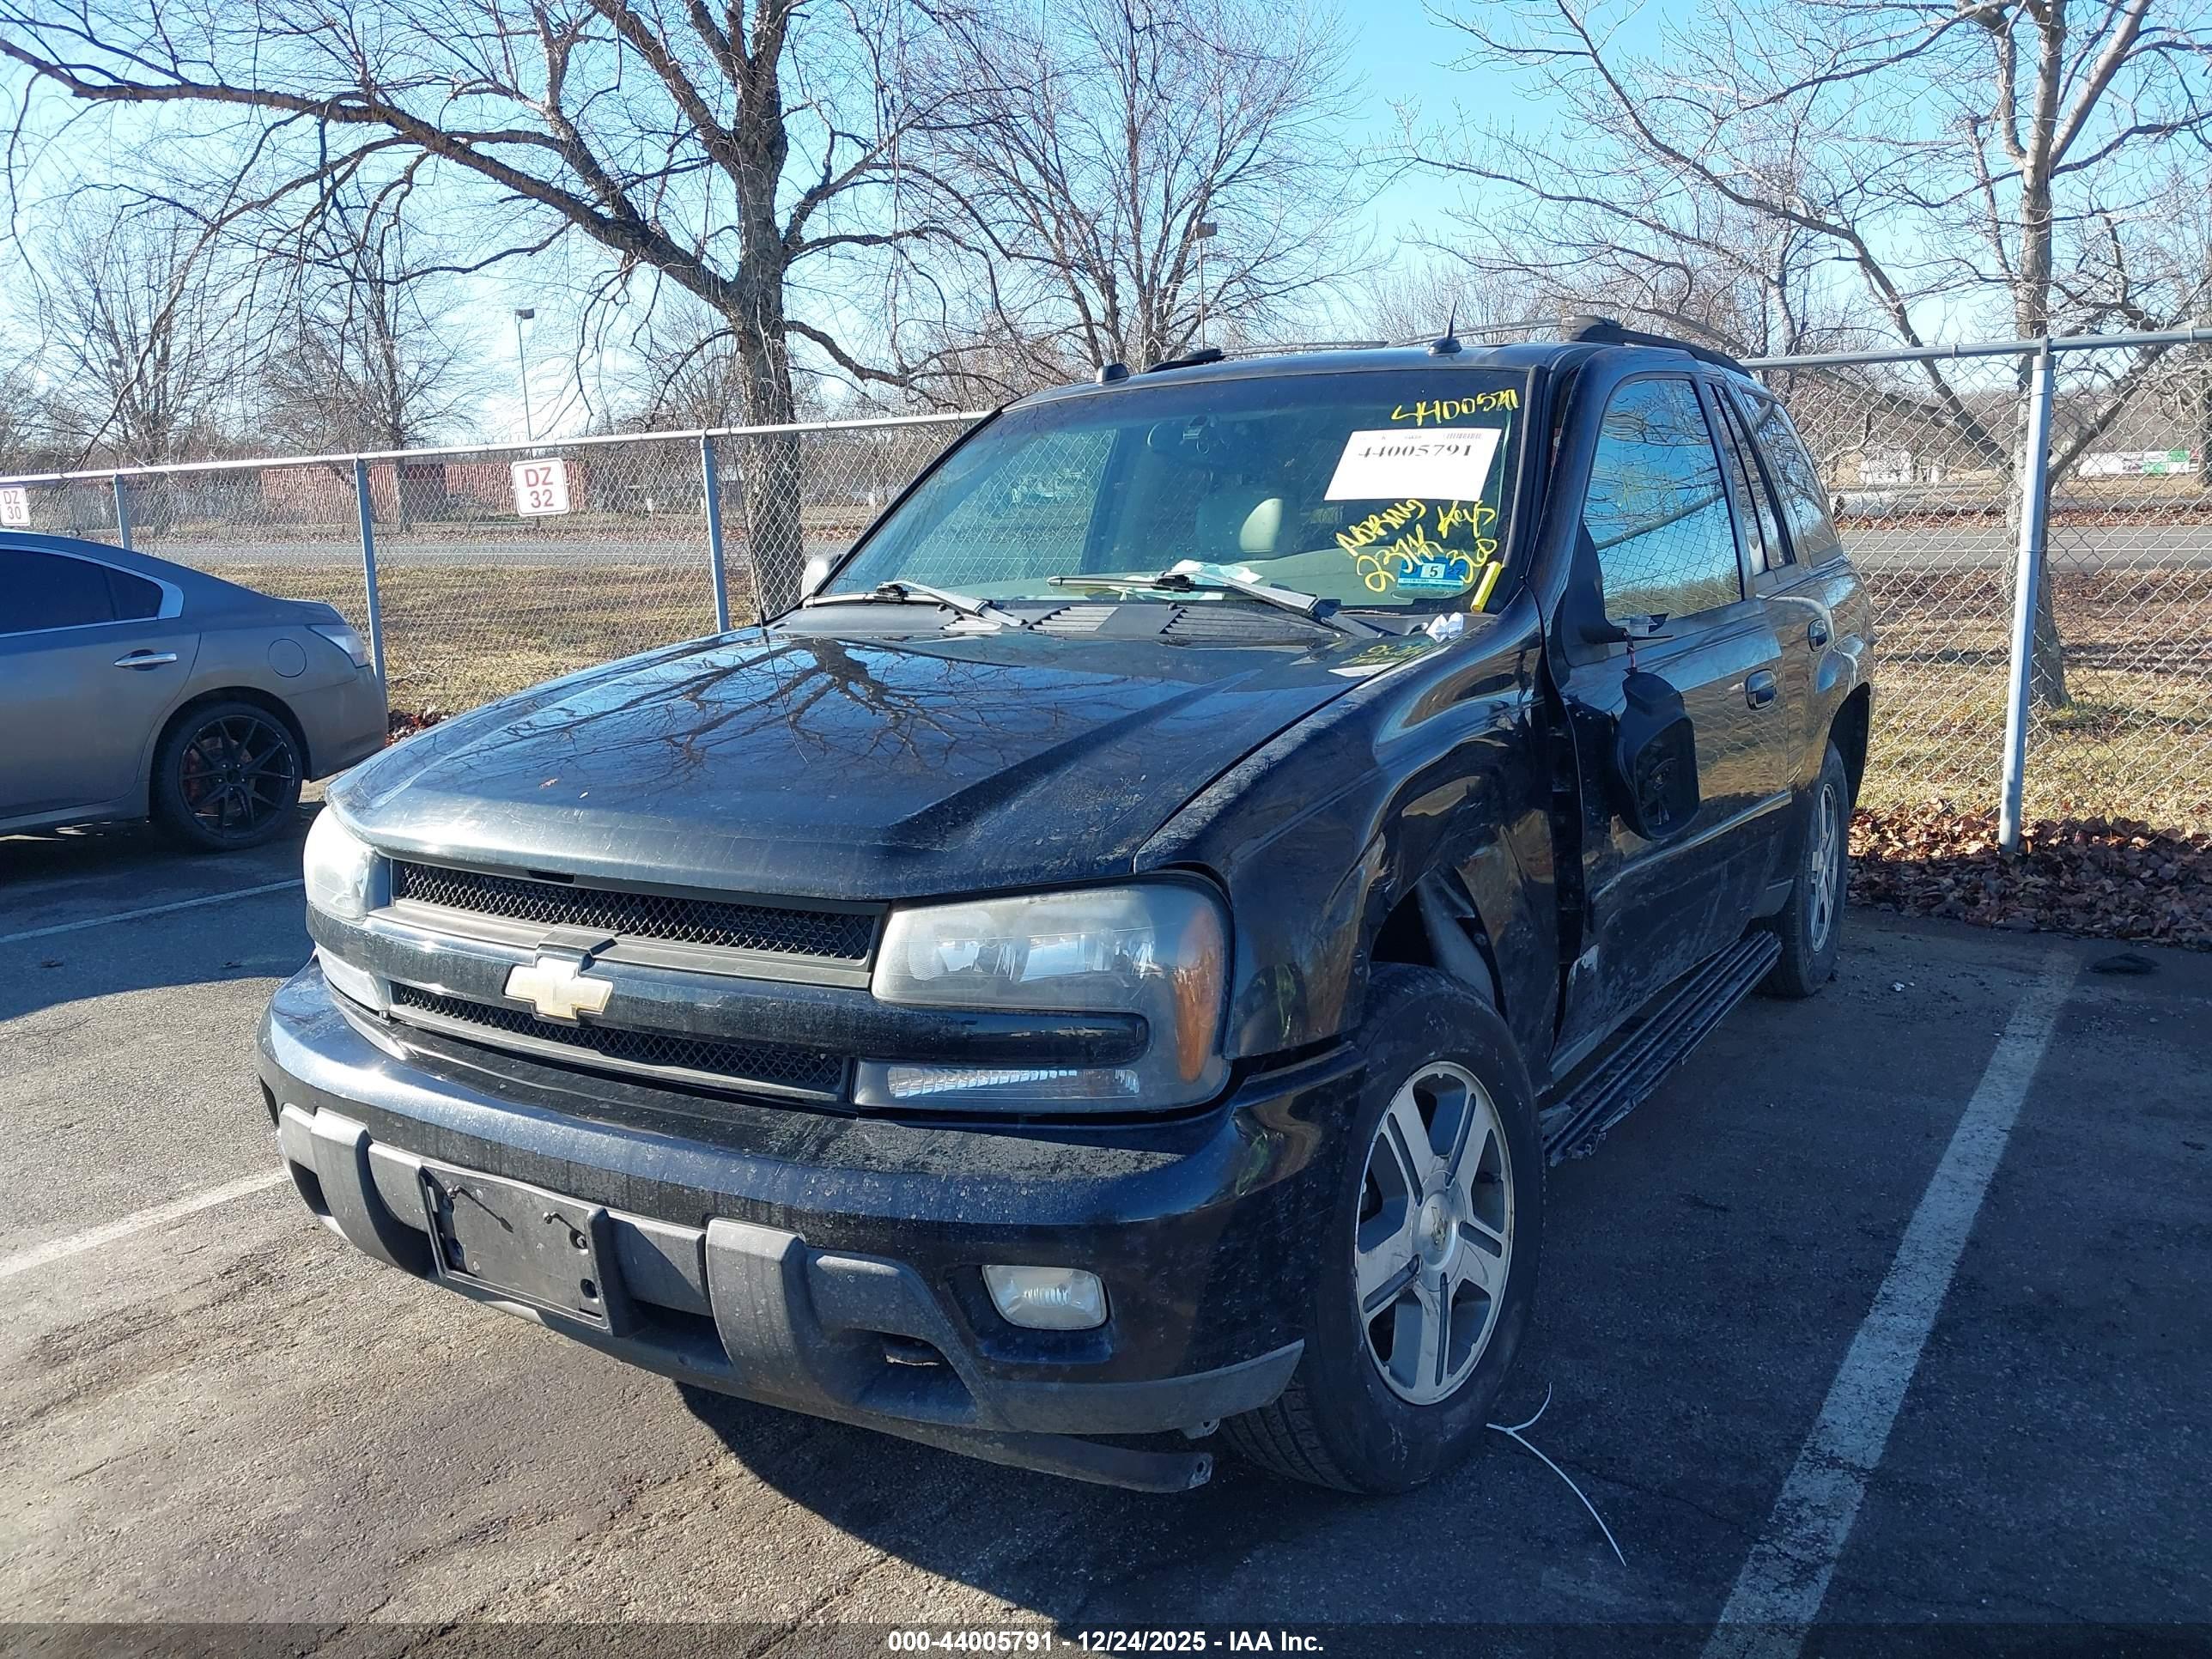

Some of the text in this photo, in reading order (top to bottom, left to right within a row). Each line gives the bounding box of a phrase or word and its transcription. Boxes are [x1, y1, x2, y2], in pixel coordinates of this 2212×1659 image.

[1358, 444, 1472, 459] 44005791
[524, 466, 554, 488] DZ
[3, 490, 21, 505] DZ
[530, 489, 554, 508] 32
[7, 506, 21, 520] 30
[1429, 566, 1439, 578] 5
